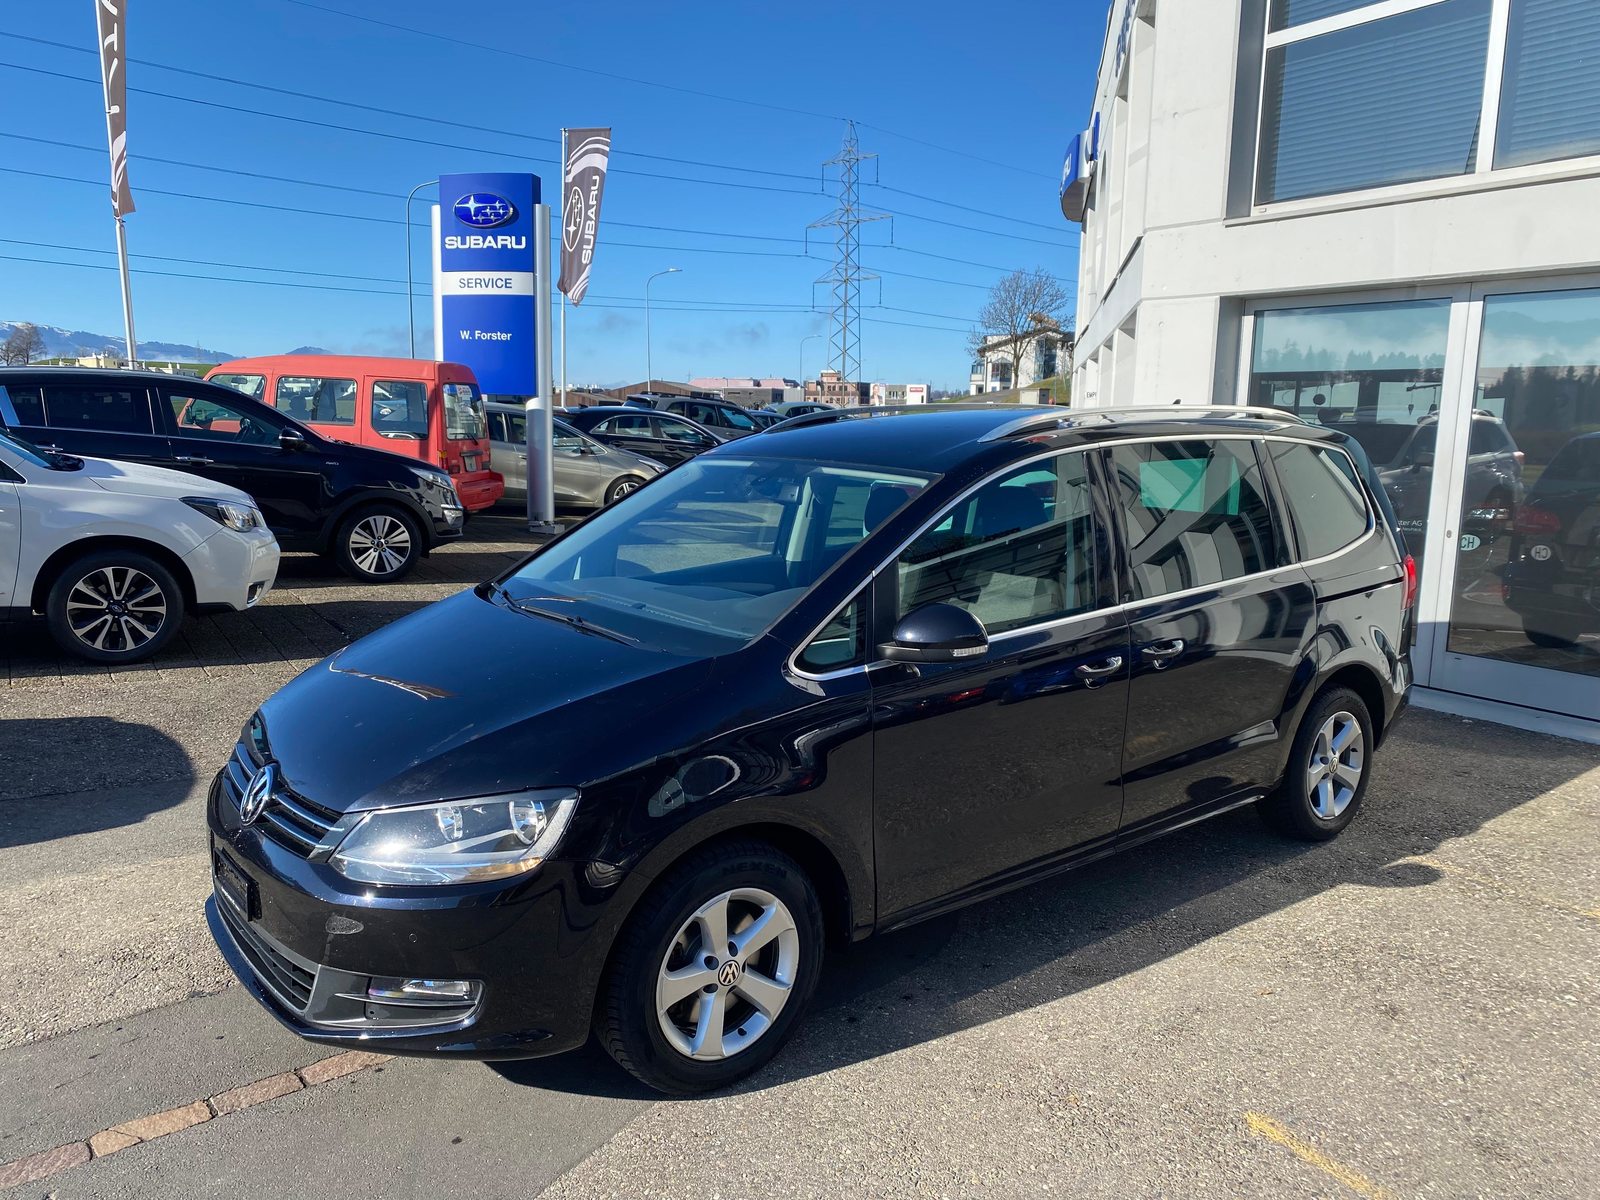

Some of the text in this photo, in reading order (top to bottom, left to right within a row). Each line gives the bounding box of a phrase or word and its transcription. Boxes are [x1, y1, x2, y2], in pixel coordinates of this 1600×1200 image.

[581, 175, 600, 264] SUBARU
[445, 235, 526, 249] SUBARU
[458, 277, 513, 289] SERVICE
[460, 330, 512, 341] W. Forster
[1411, 519, 1423, 527] AG
[1461, 537, 1475, 549] CH
